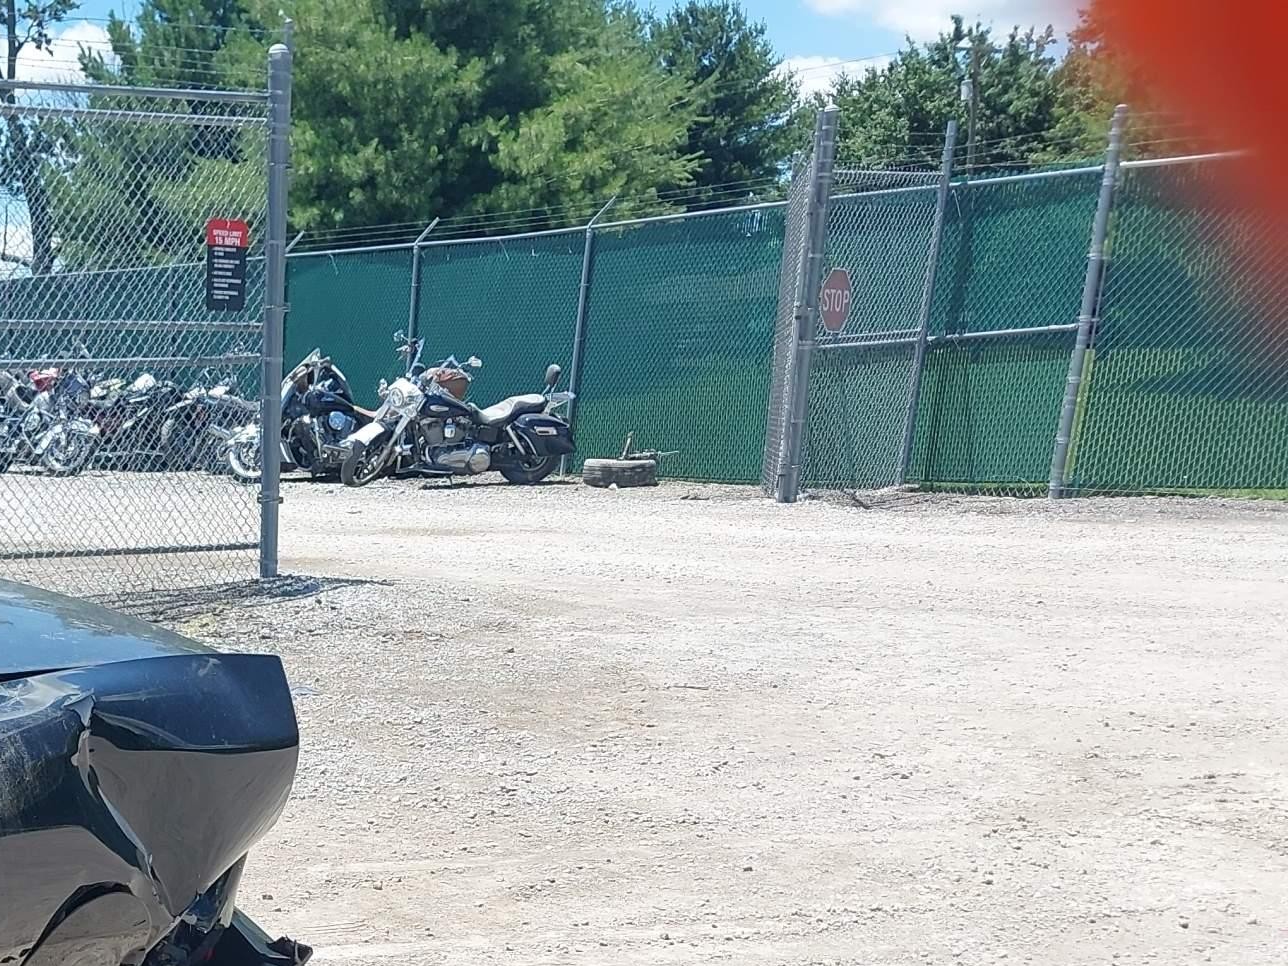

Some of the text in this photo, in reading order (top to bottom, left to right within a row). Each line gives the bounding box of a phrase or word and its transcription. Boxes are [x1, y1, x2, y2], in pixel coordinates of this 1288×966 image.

[215, 236, 240, 246] 15 MPH
[822, 288, 850, 313] STOP
